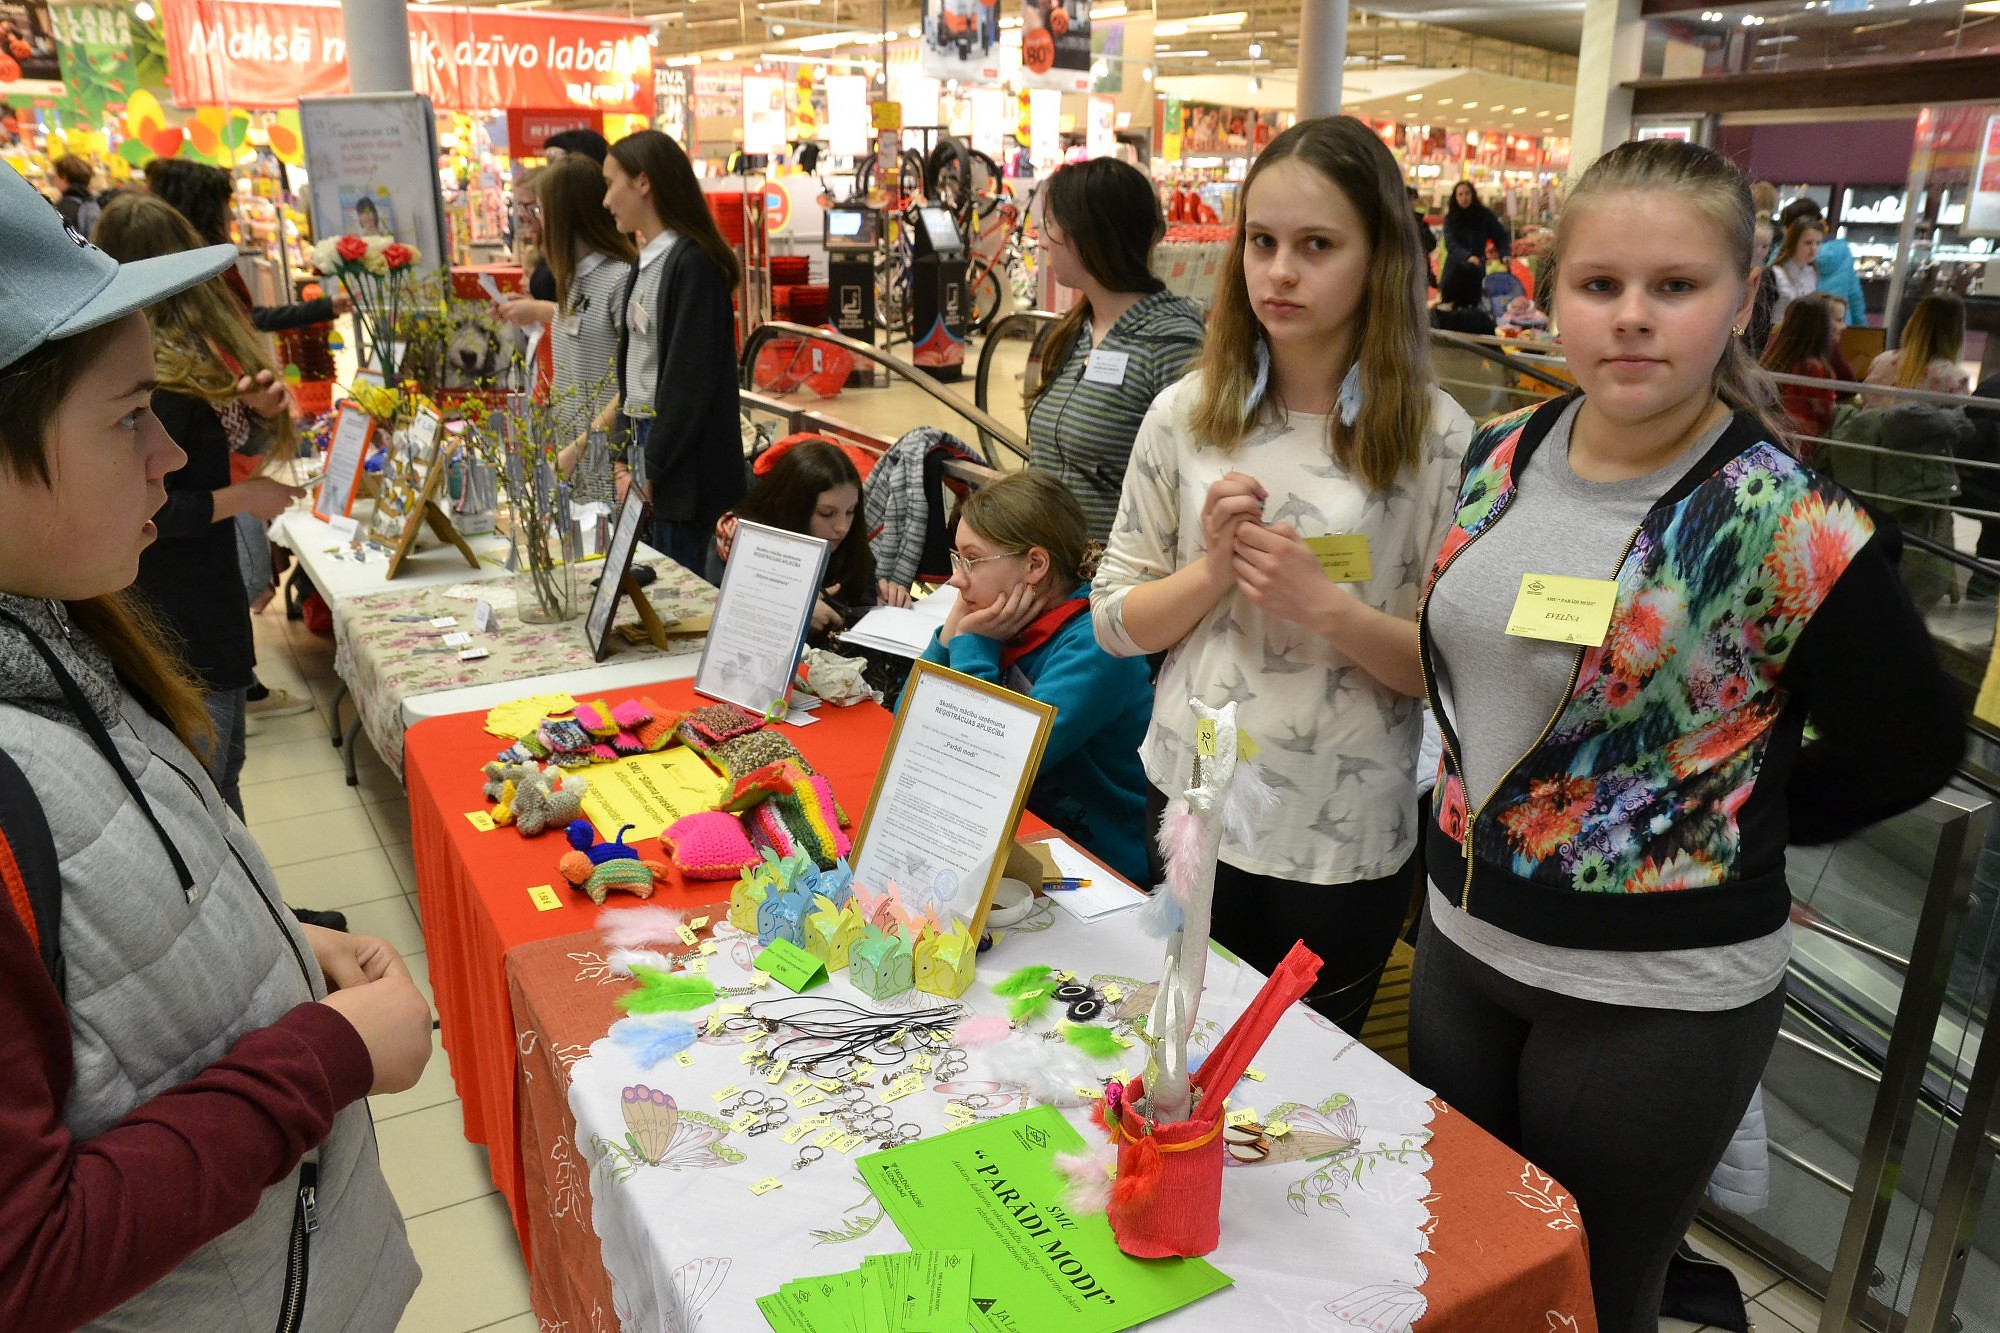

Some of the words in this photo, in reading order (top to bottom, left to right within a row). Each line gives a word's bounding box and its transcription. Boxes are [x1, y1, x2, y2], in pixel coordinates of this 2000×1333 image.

[188, 20, 311, 64] Maksā
[1545, 612, 1580, 622] EVELĪNA
[1045, 1206, 1079, 1231] SMU
[994, 1230, 1004, 1239] un
